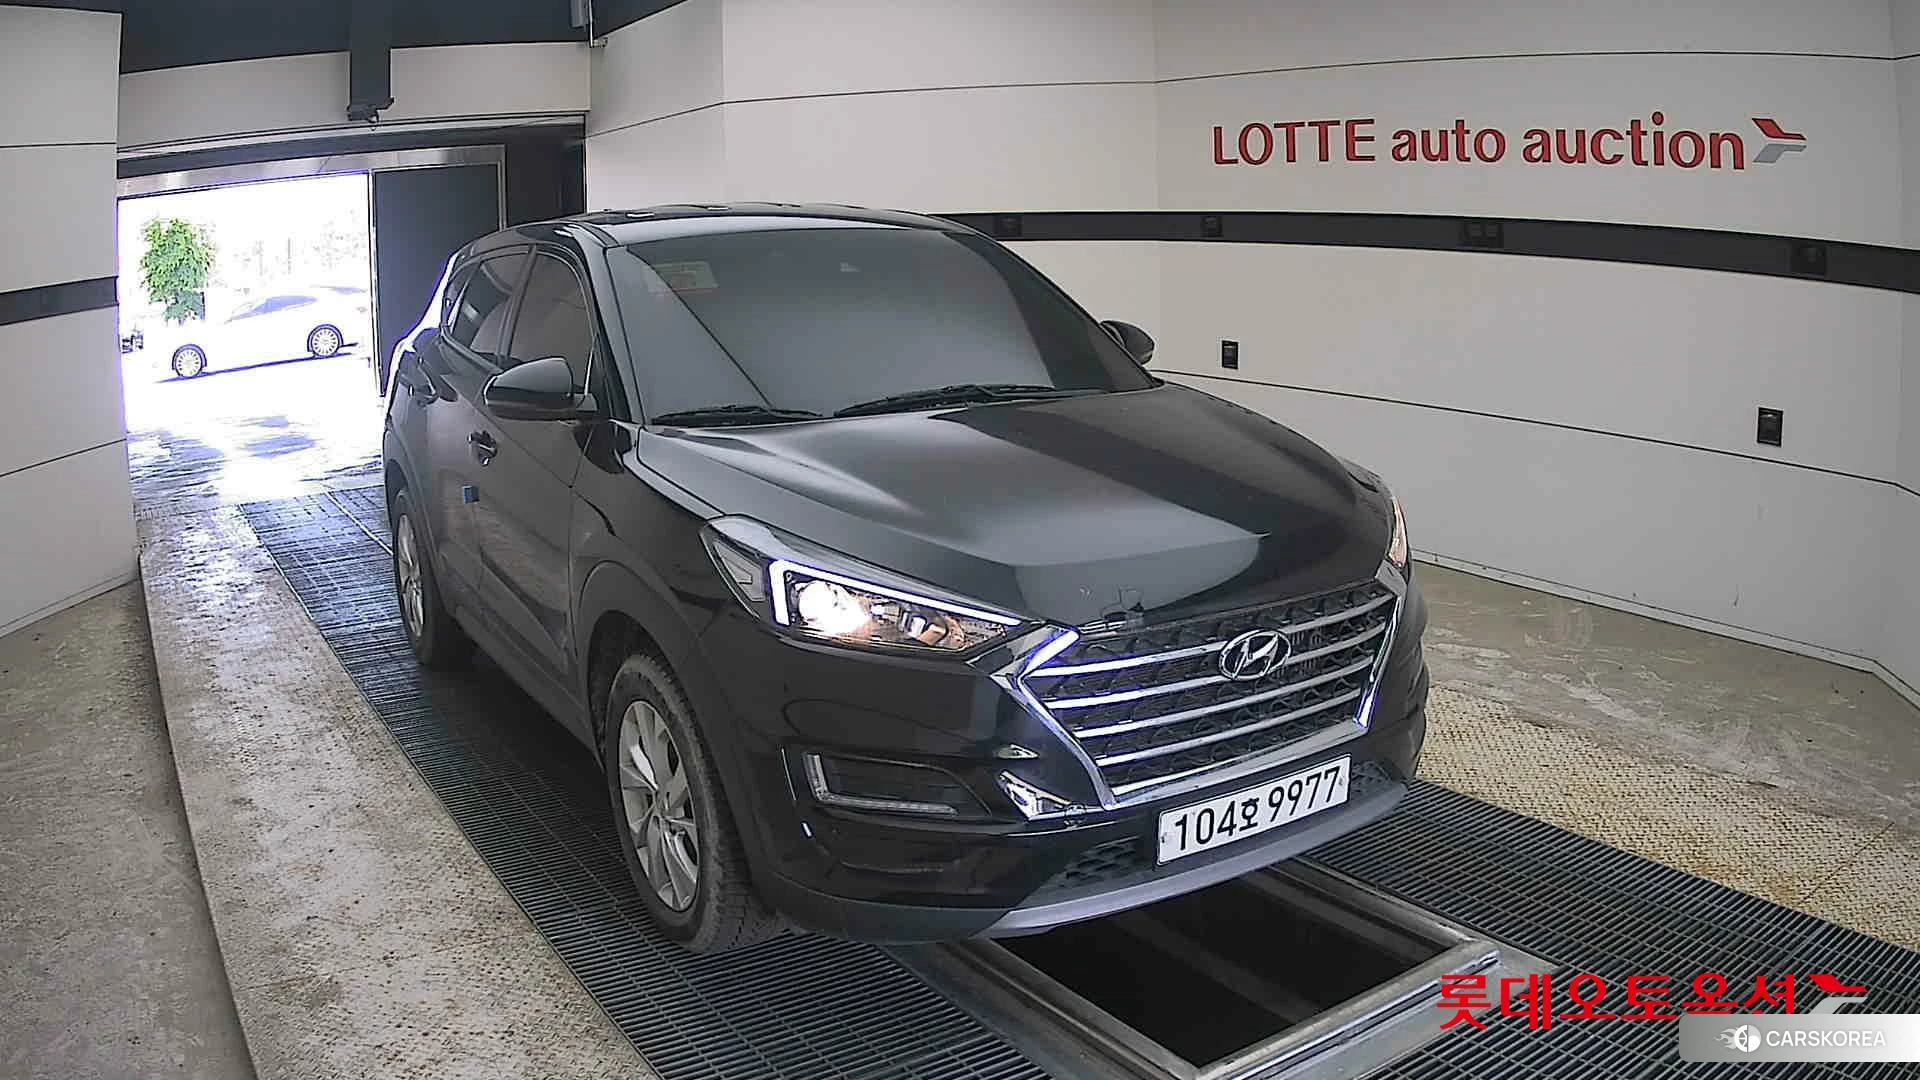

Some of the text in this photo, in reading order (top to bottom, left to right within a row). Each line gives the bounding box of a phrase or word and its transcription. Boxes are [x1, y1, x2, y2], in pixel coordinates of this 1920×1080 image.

[1212, 111, 1746, 171] LOTTE auto auction
[1175, 765, 1341, 851] 104호 9977
